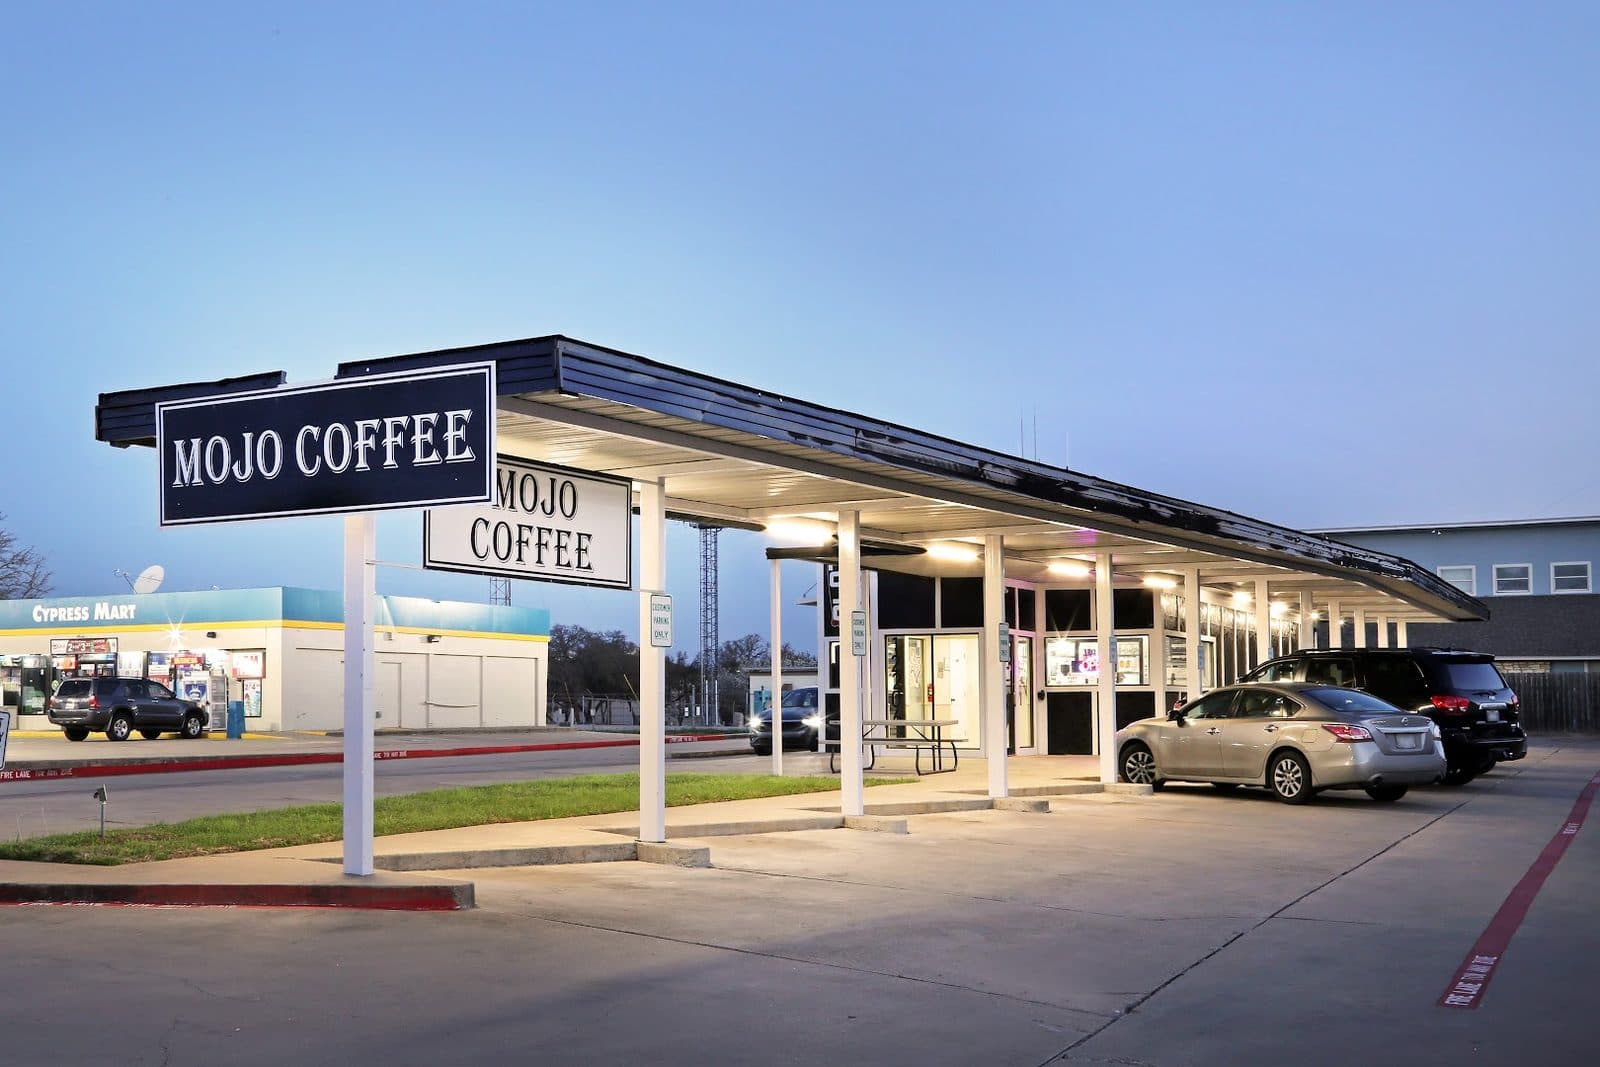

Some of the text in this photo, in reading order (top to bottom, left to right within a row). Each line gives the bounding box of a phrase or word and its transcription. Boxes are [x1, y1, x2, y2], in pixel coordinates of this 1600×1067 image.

[171, 408, 477, 488] MOJO COFFEE
[493, 468, 578, 520] MOJO
[470, 518, 593, 573] COFFEE
[32, 602, 137, 623] CYPRESS MART
[655, 631, 669, 639] ONLY
